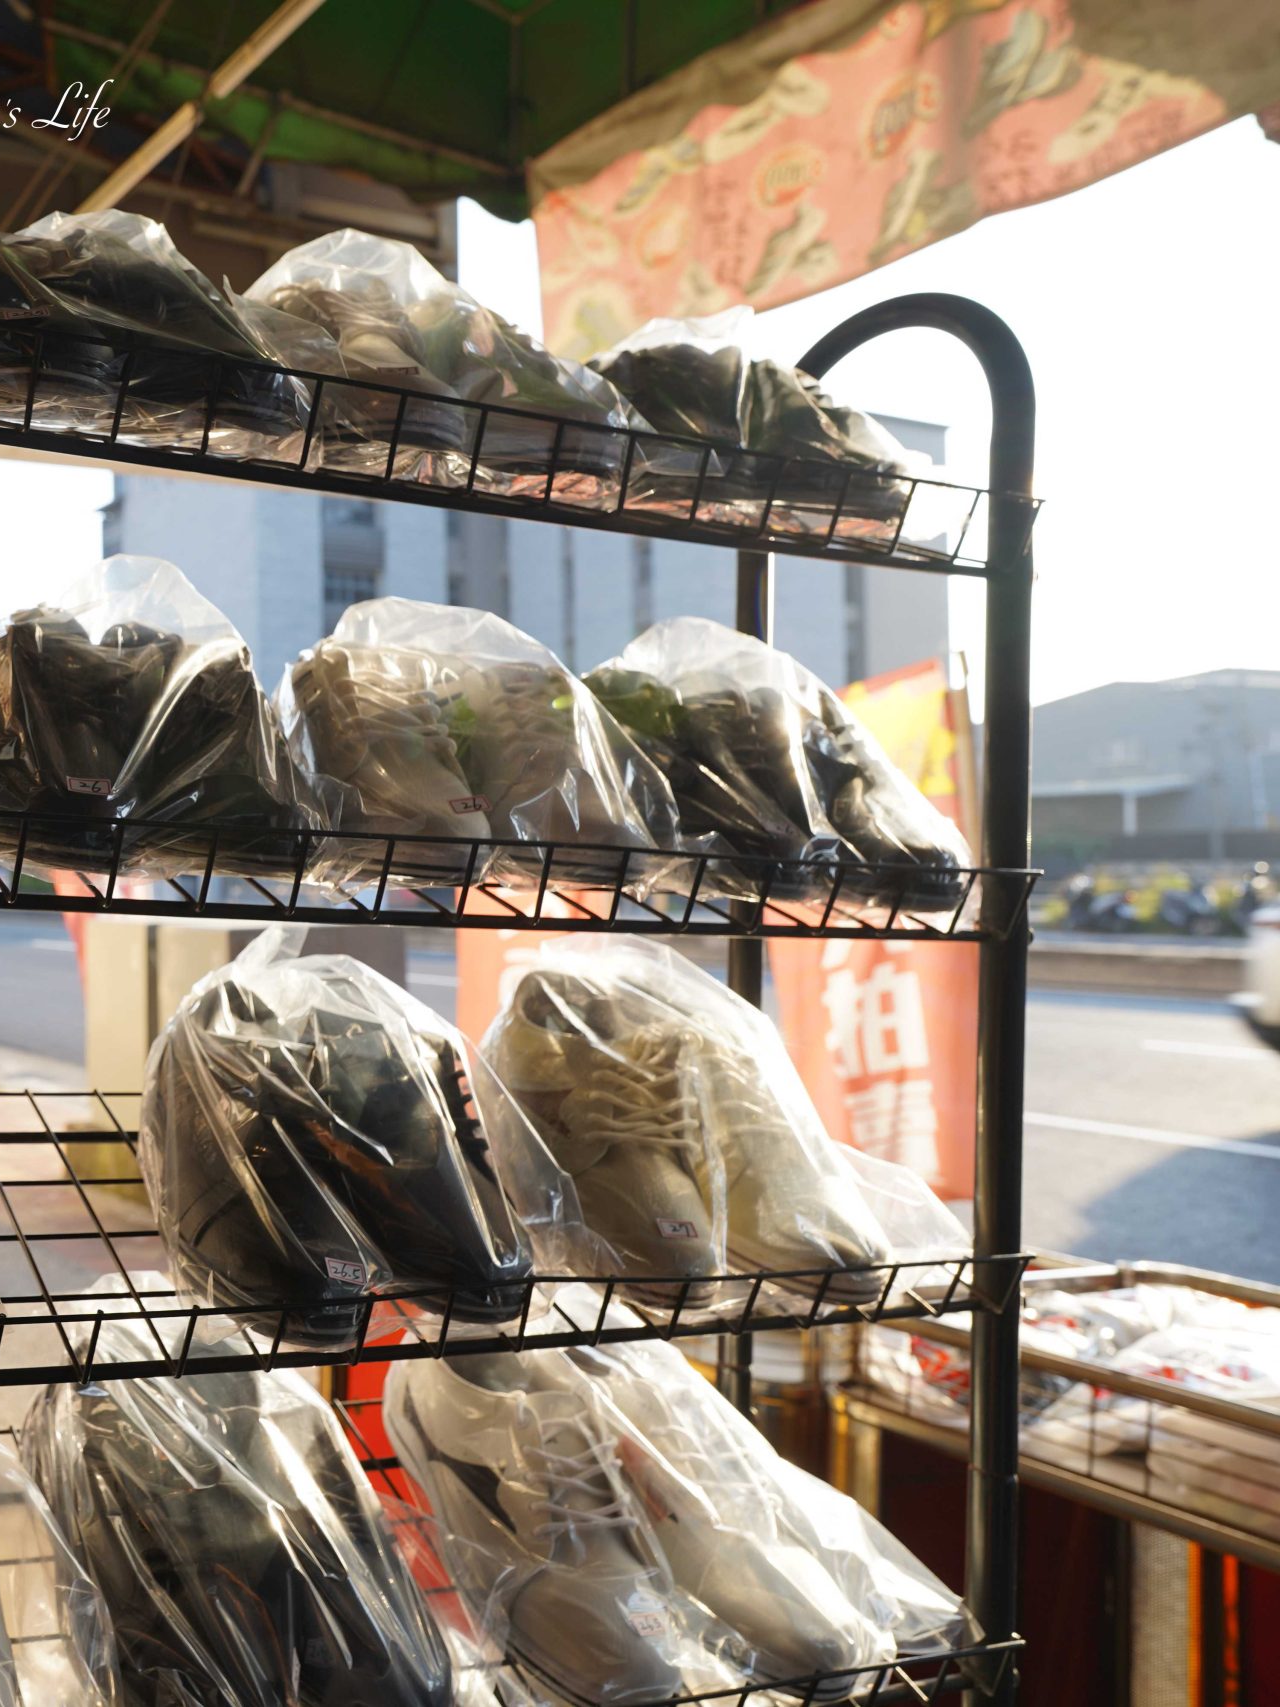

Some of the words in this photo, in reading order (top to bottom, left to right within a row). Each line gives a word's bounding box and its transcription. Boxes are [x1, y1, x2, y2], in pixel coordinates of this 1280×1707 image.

[80, 780, 101, 793] 26
[461, 798, 482, 811] 26
[331, 1262, 361, 1280] 26.5
